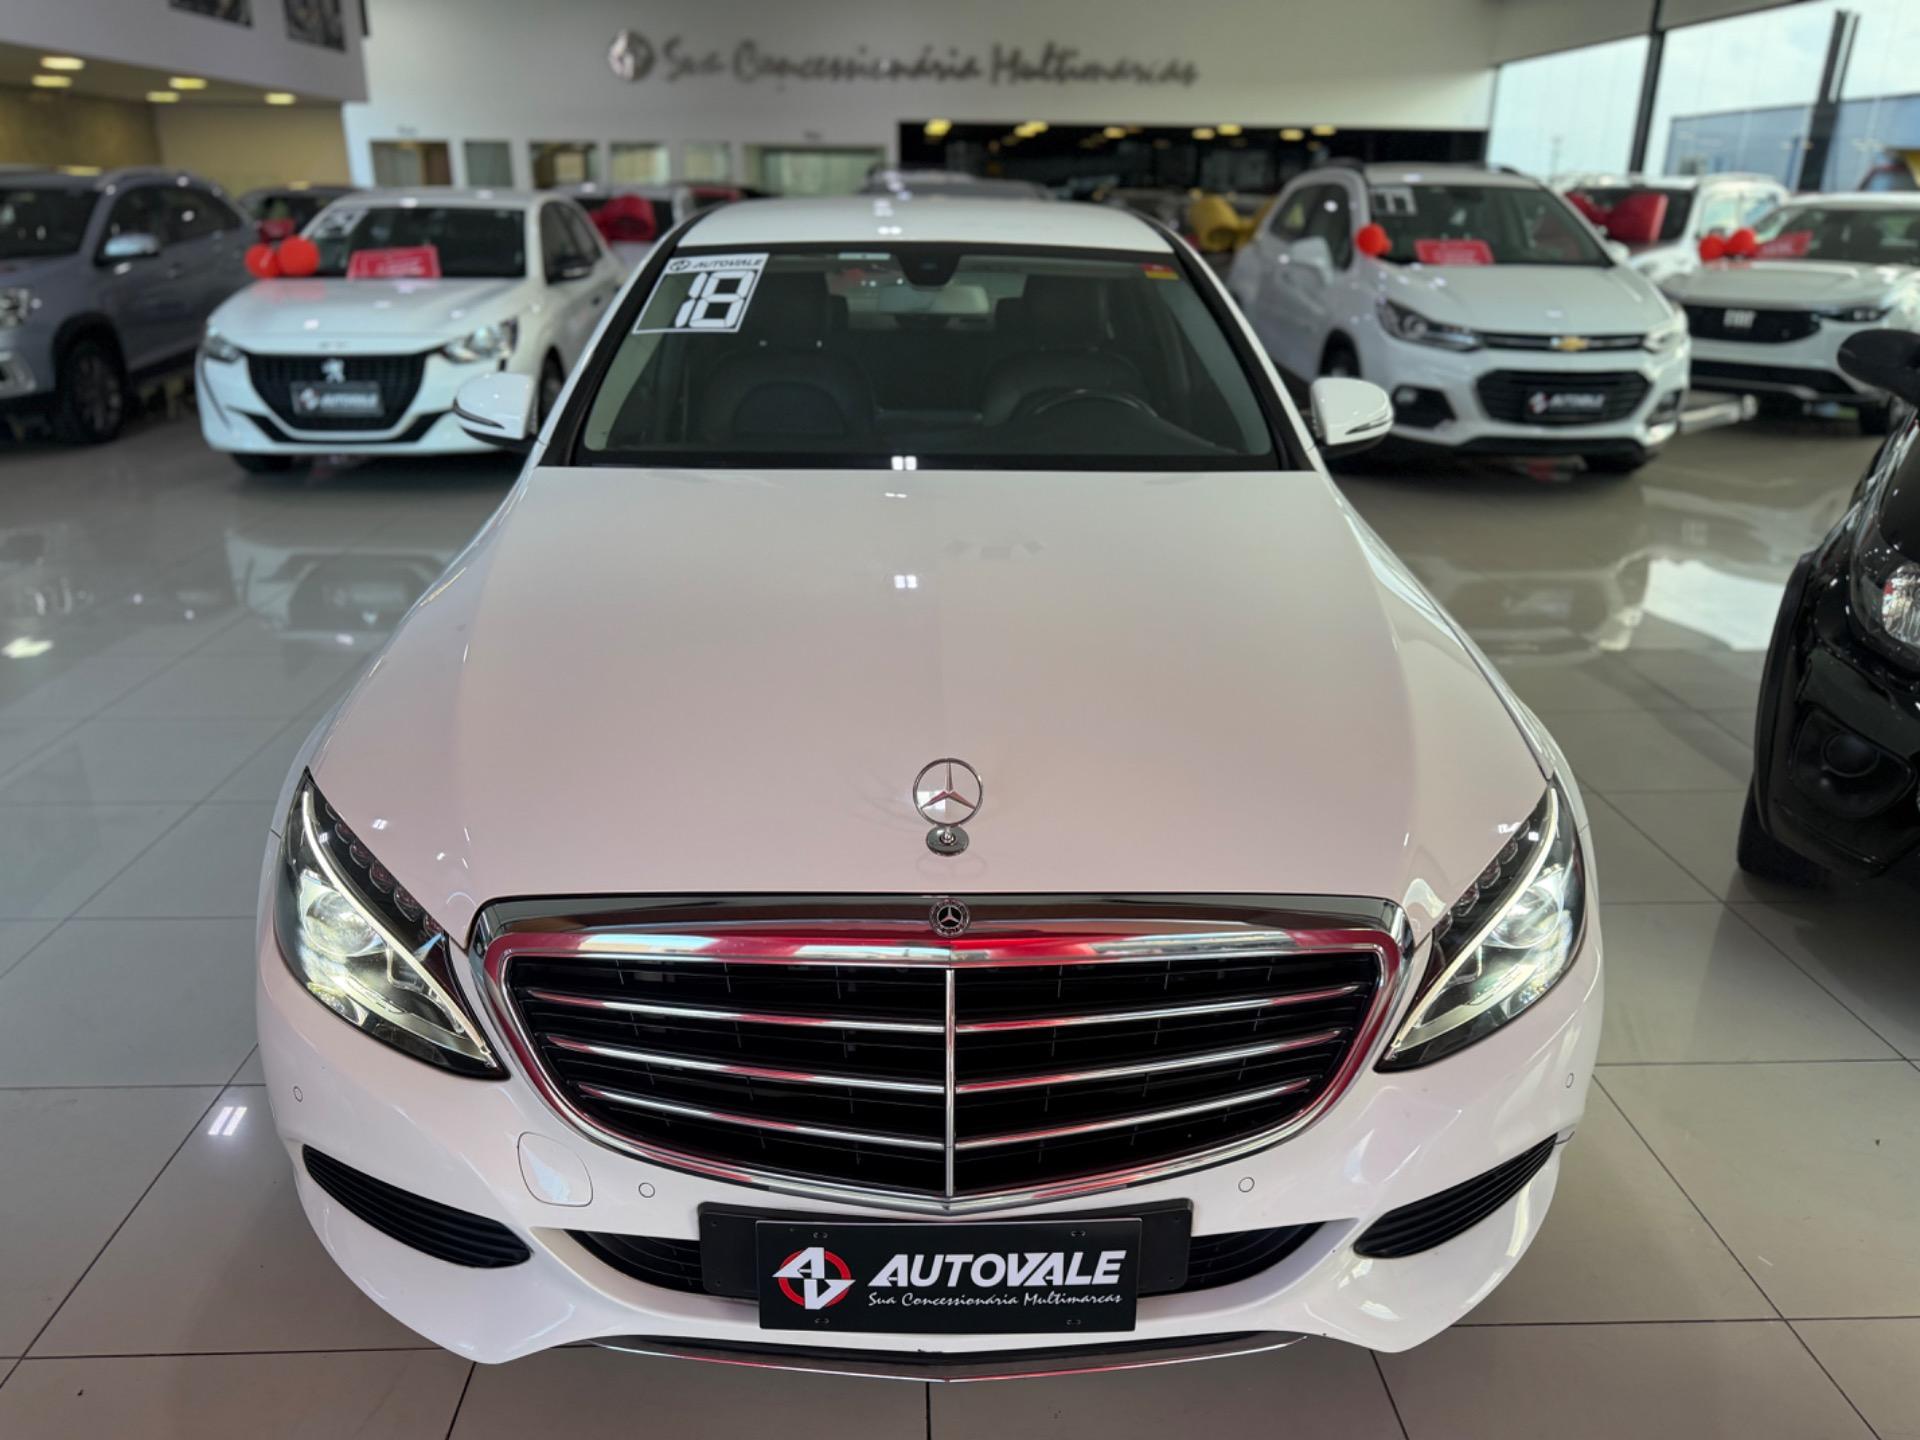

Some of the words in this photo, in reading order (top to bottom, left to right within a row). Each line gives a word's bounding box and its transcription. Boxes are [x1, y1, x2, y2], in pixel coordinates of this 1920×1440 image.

[674, 270, 756, 329] 18
[867, 1250, 1127, 1288] AUTOVALE
[868, 1291, 896, 1307] Sua
[901, 1292, 1019, 1307] Concessionária
[1023, 1290, 1123, 1306] Multimarcas
